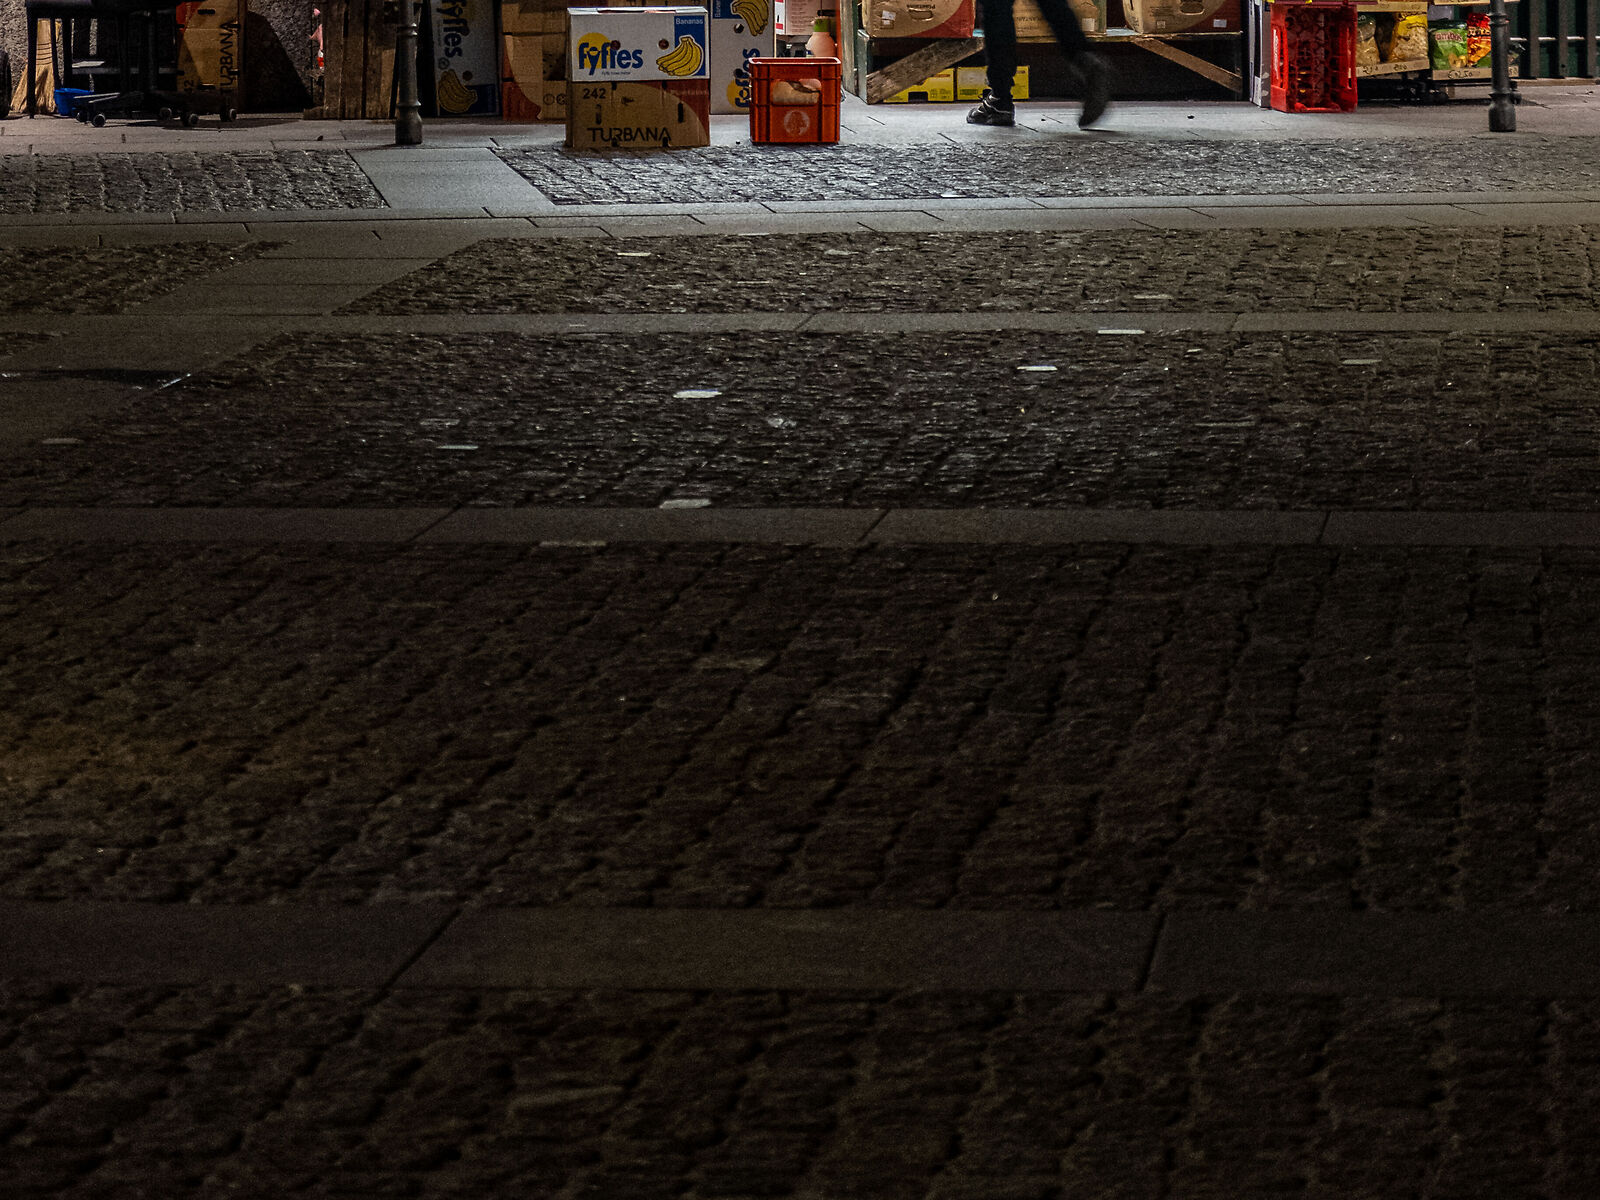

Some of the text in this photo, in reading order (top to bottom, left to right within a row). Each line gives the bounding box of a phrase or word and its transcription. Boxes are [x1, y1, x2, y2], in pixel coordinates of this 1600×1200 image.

[578, 42, 644, 76] fyffes
[582, 87, 607, 100] 242
[586, 127, 672, 142] TURBANA
